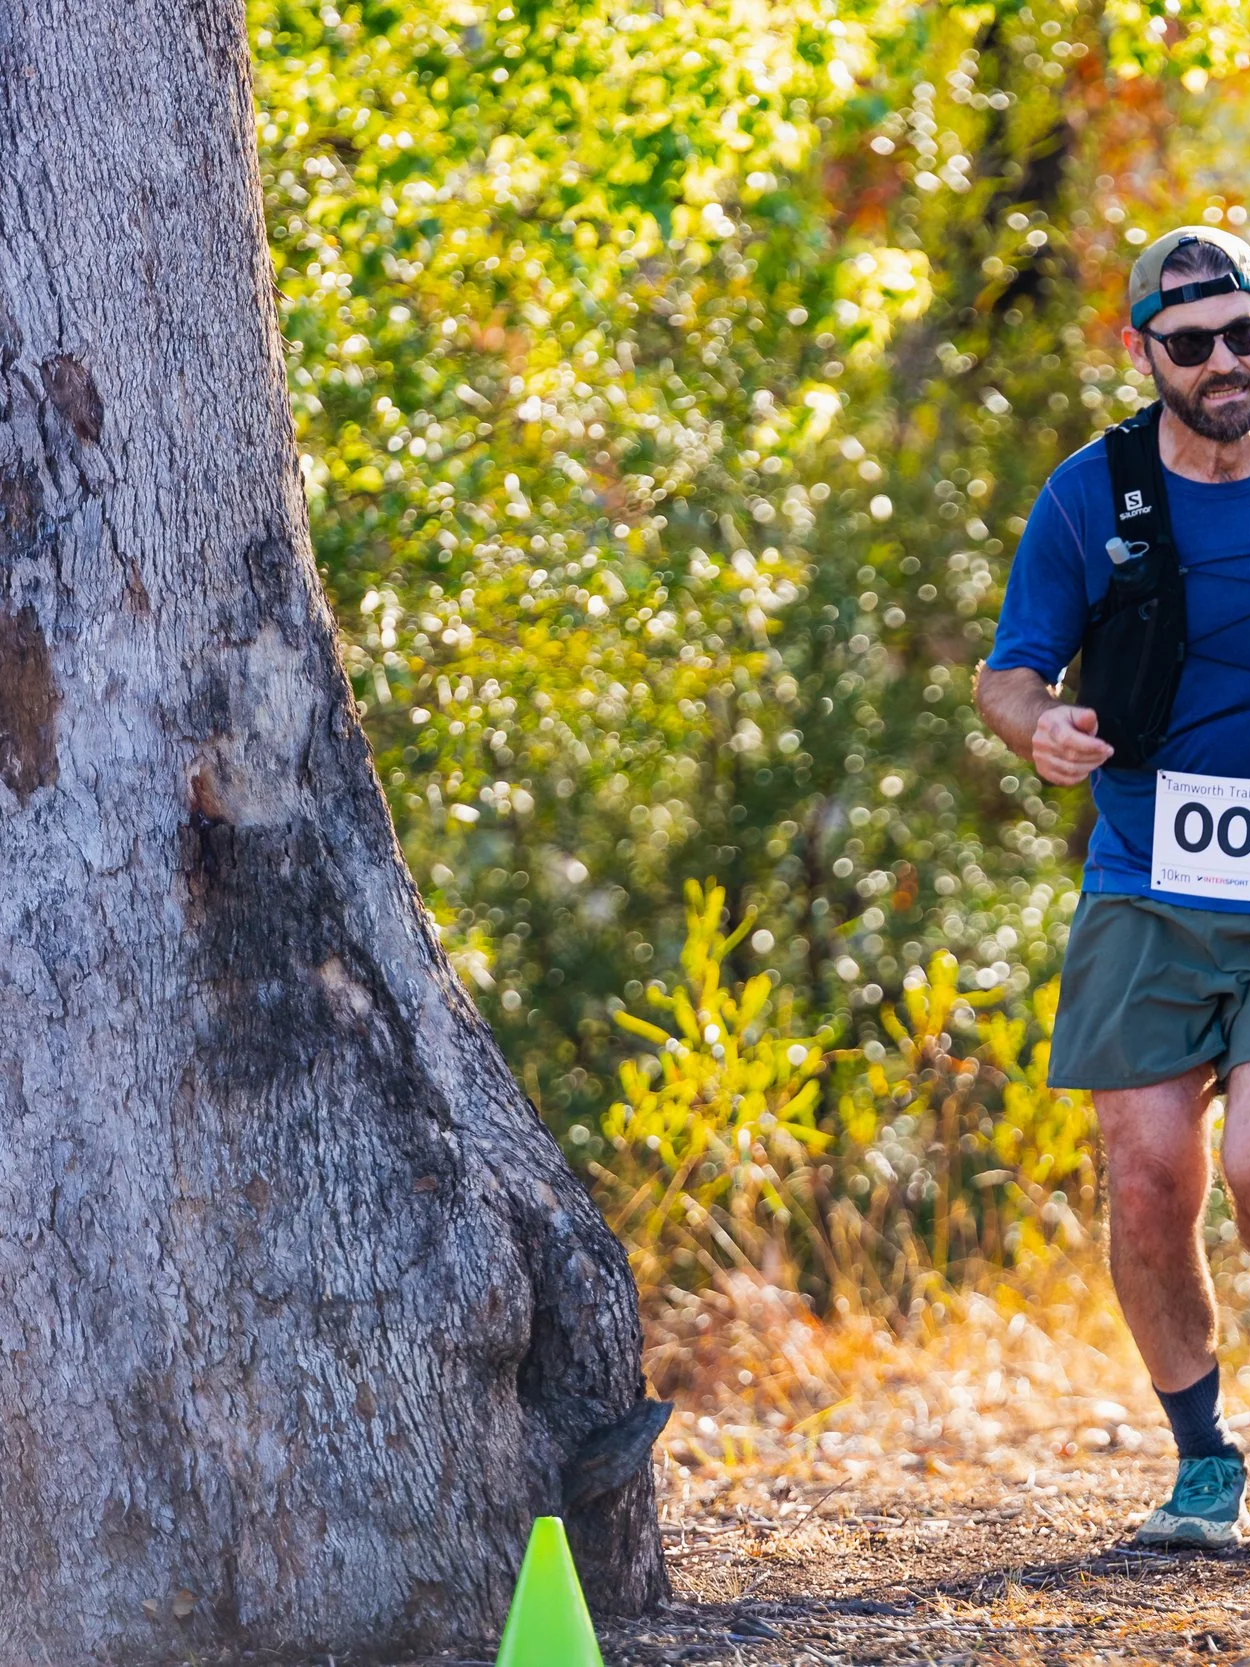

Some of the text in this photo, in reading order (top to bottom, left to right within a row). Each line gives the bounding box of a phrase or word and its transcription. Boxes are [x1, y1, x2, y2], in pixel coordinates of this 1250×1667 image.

[1167, 779, 1224, 796] Tamworth
[1160, 867, 1191, 883] 10km
[1203, 876, 1248, 886] INTERSPORT
